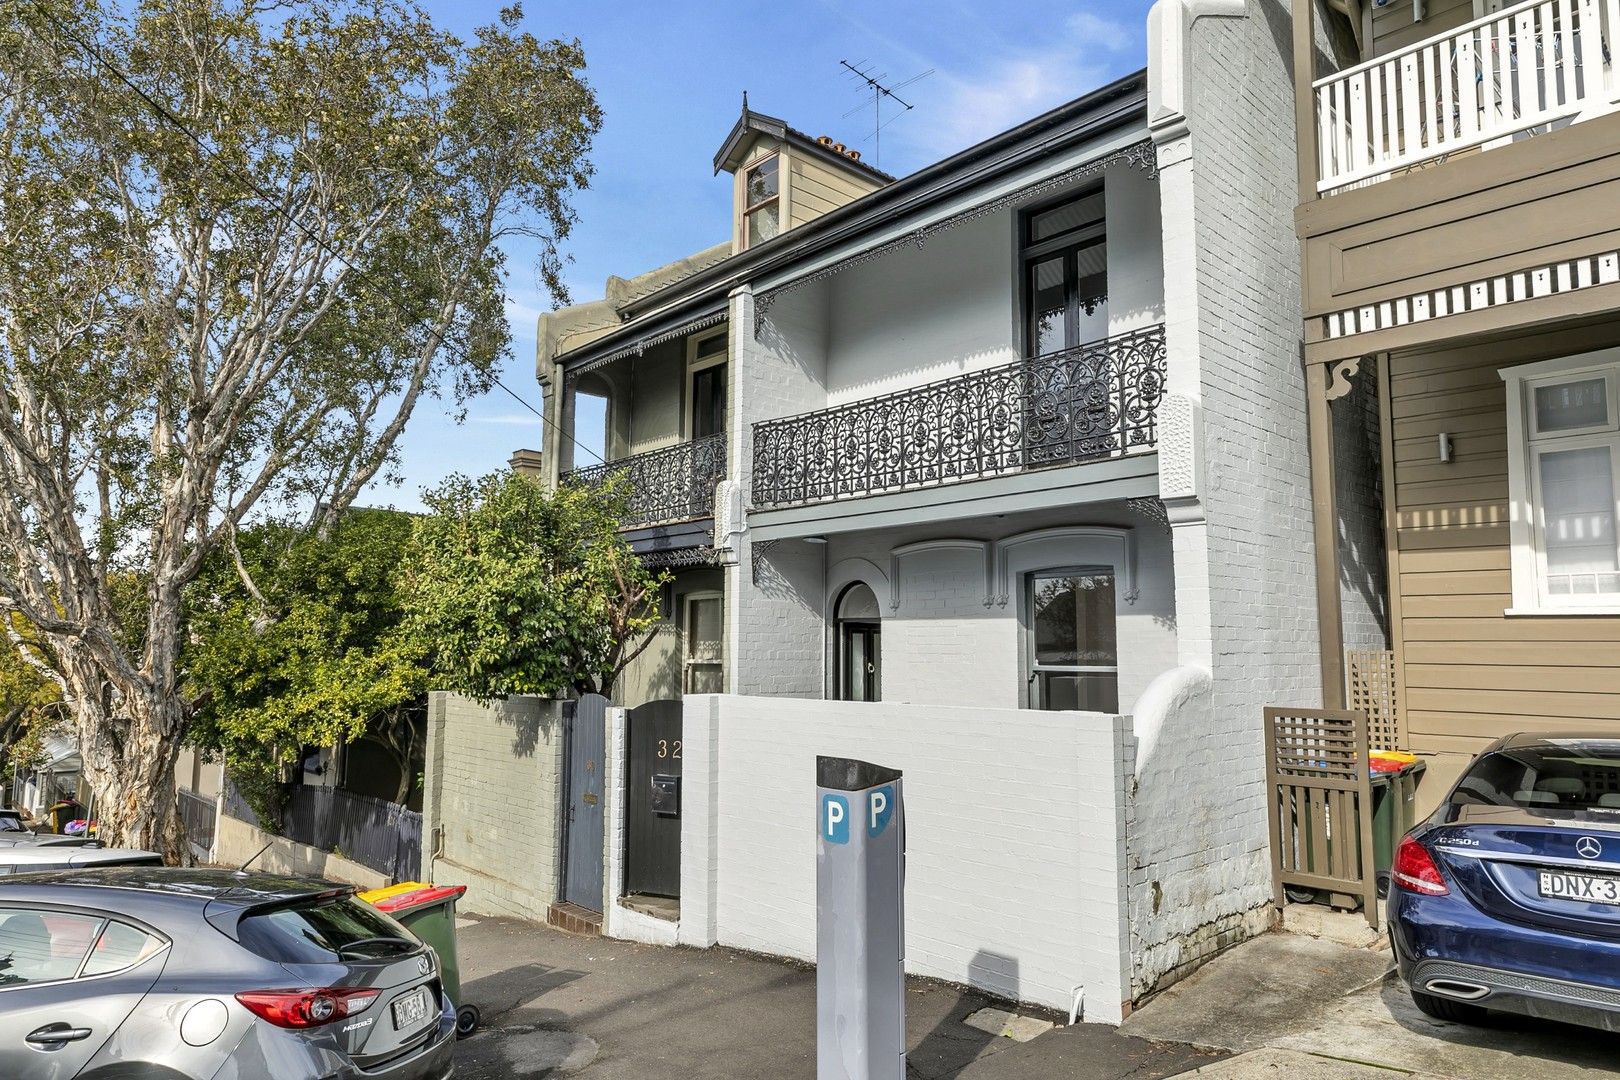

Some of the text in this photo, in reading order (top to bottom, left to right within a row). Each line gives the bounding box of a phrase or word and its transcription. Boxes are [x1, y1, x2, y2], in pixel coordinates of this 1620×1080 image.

[657, 739, 682, 759] 32
[828, 801, 844, 836] P
[871, 792, 886, 828] P
